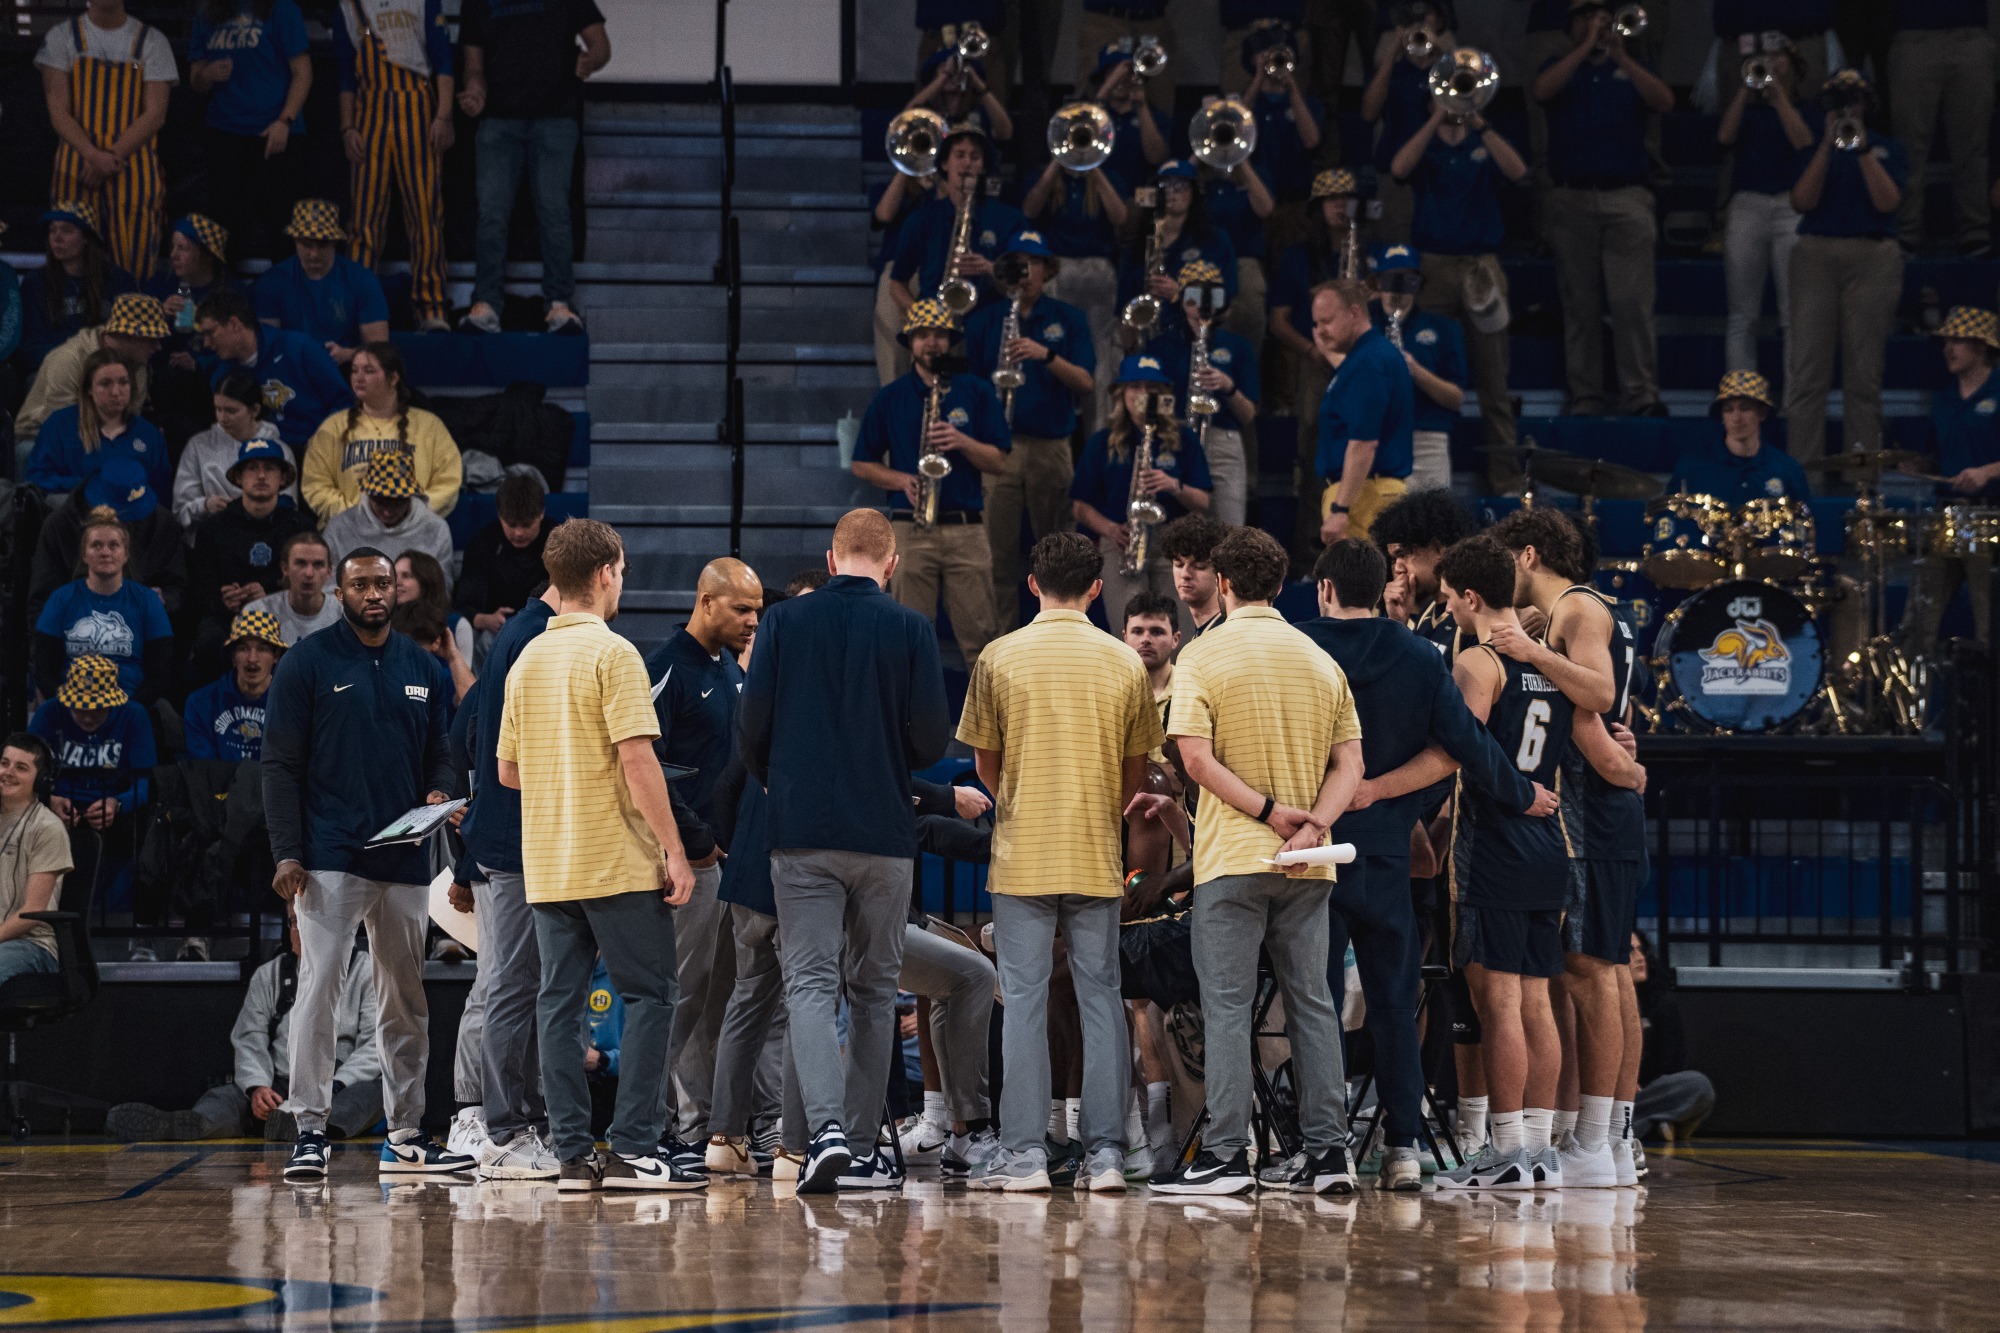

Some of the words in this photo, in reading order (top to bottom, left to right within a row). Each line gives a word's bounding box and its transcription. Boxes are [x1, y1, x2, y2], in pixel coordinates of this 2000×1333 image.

[1703, 666, 1787, 684] JACKRABBITS
[214, 709, 235, 735] SOUTH
[1516, 699, 1551, 772] 6
[58, 740, 123, 768] JACKS
[711, 1134, 727, 1143] NIKE
